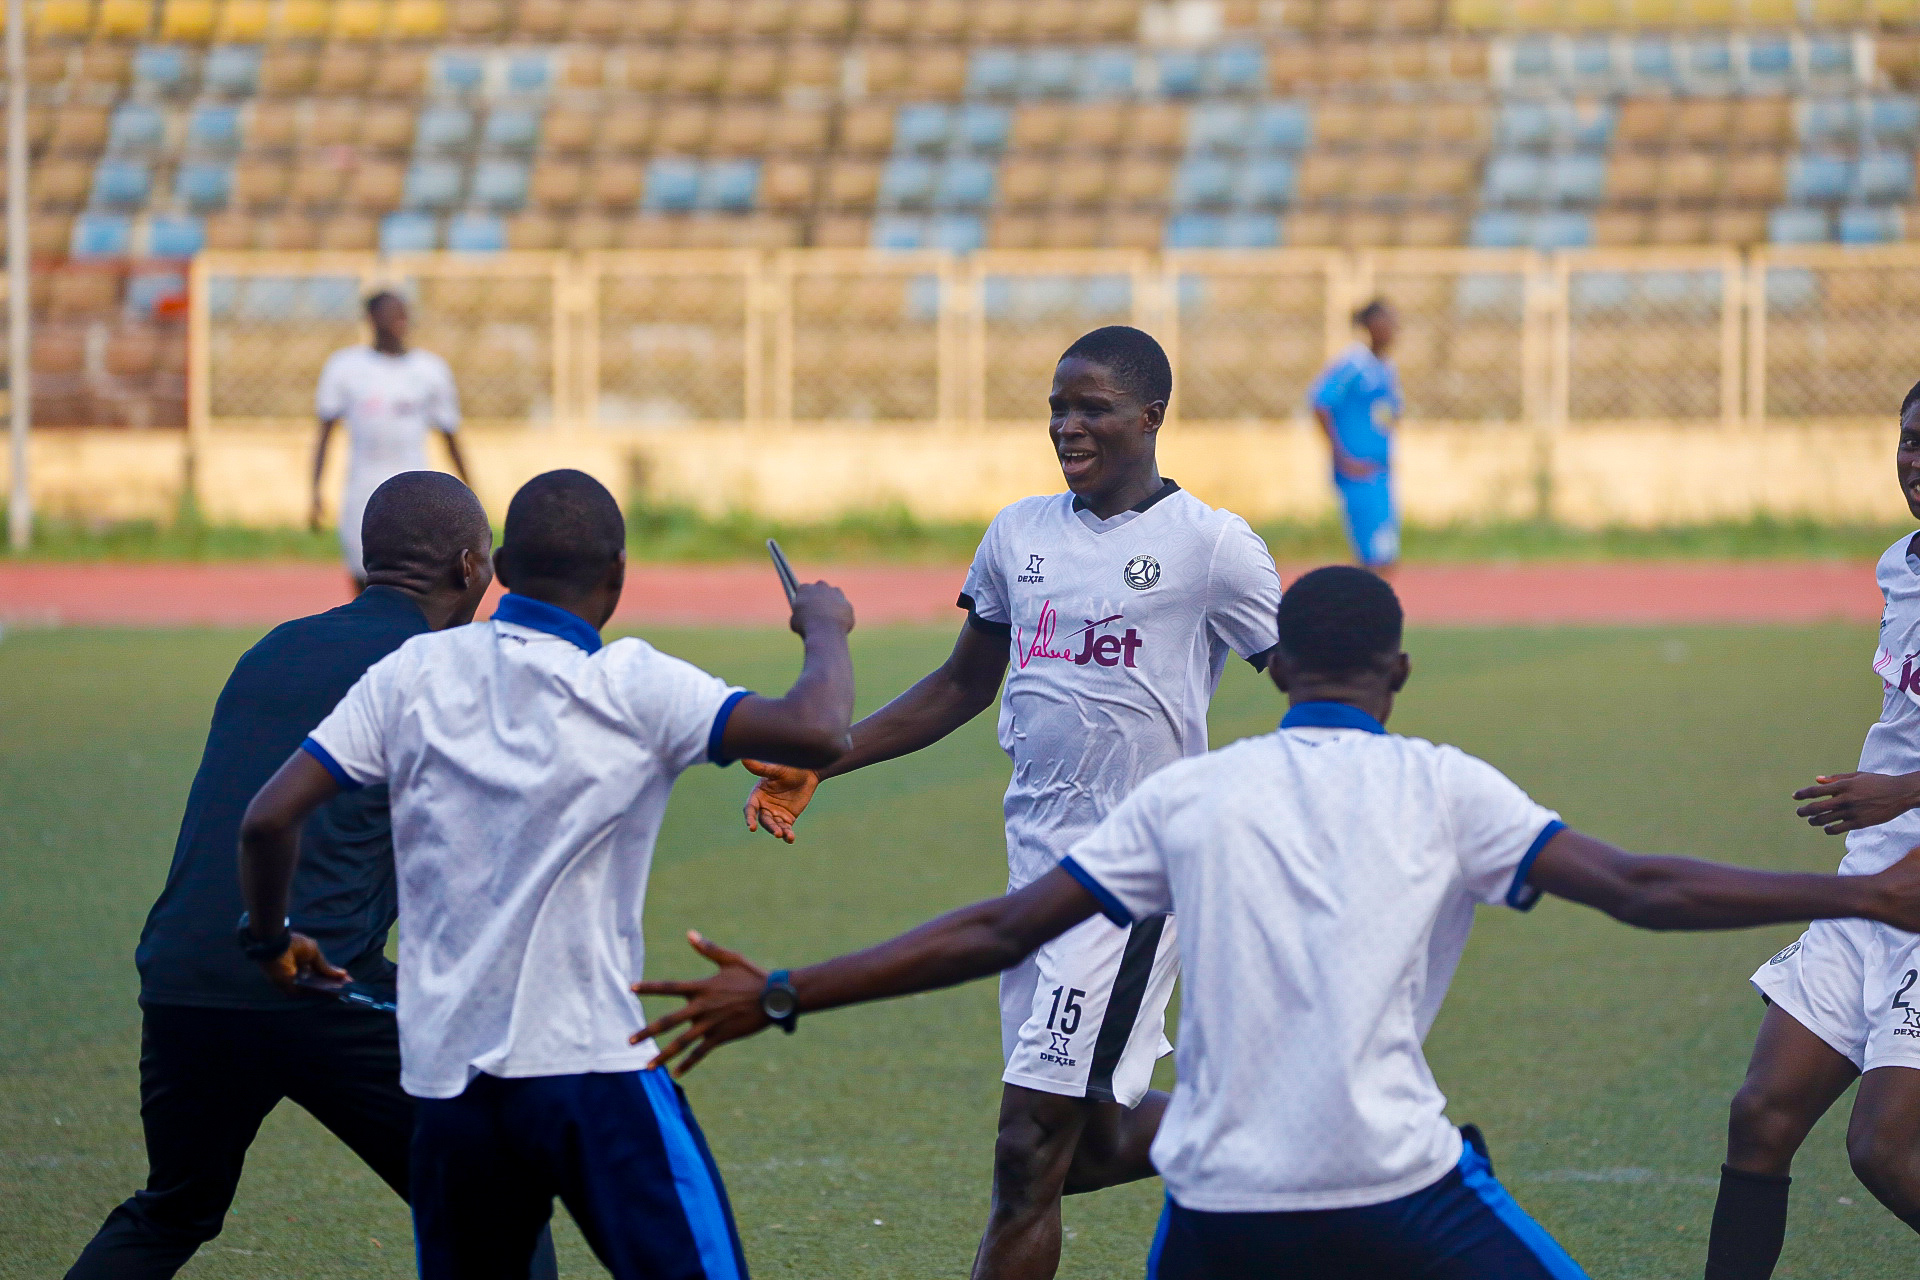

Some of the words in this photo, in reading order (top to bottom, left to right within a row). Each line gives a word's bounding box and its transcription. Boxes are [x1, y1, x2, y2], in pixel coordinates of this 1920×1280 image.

[1017, 575, 1045, 585] DEXIE
[1046, 985, 1086, 1035] 15
[1893, 1028, 1920, 1039] DEXI
[1040, 1052, 1076, 1066] DEXIE
